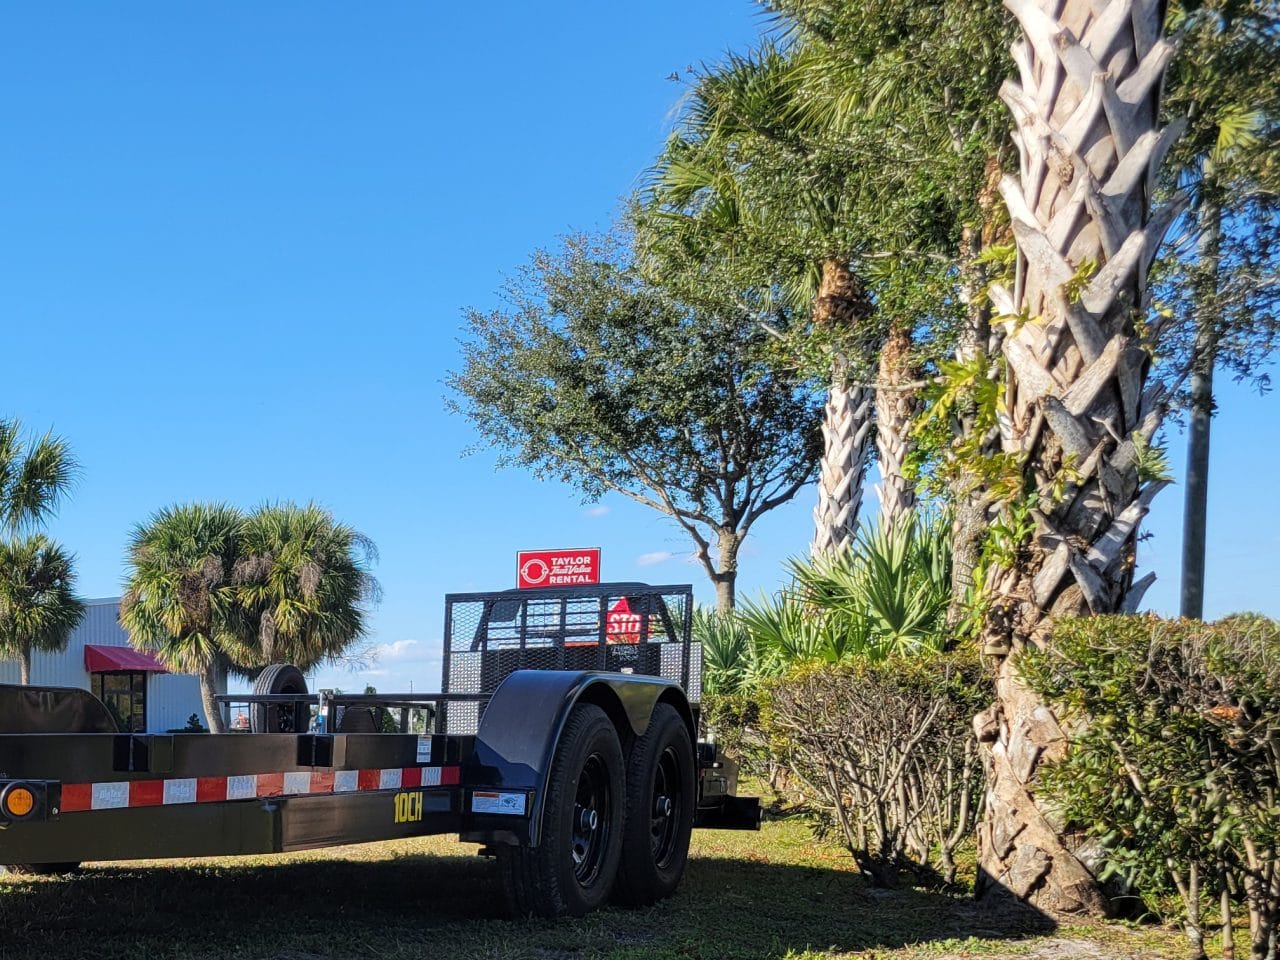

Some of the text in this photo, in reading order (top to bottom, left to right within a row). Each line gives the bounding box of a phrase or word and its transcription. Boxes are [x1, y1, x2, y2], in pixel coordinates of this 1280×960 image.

[551, 556, 591, 566] TAYLOR
[549, 575, 592, 584] RENTAL
[609, 613, 641, 633] STO
[394, 792, 423, 824] 10CH
